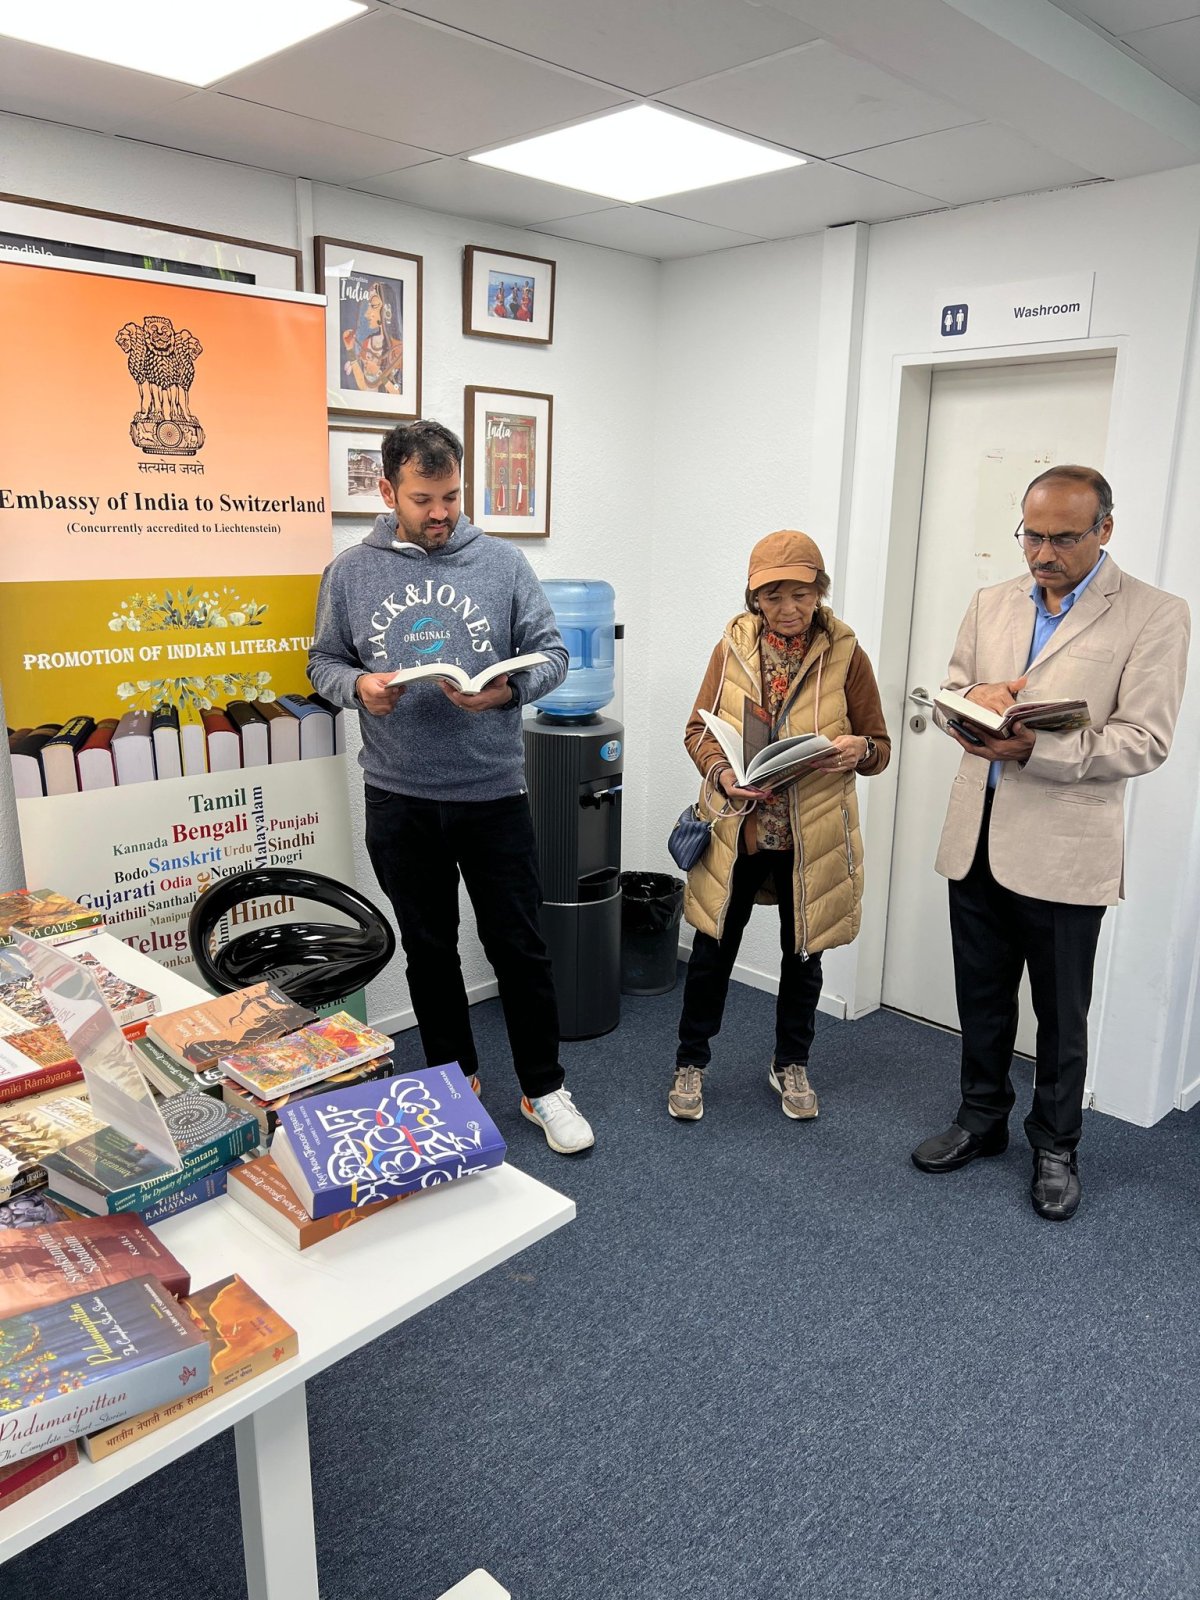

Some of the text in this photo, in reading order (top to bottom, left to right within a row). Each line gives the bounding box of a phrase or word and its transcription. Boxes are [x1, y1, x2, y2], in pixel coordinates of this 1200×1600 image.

[340, 278, 370, 302] India
[1013, 302, 1080, 319] Washroom
[486, 420, 512, 440] India
[138, 460, 205, 475] सत्यमेव जयते
[0, 489, 325, 515] Embassy of India to Switzerland
[66, 522, 281, 535] (Concurrently accredited to Liechtenstein)
[403, 630, 451, 643] ORIGINALS
[23, 648, 134, 670] PROMOTION
[139, 645, 163, 661] OF
[167, 642, 226, 660] INDIAN
[188, 788, 247, 814] Tamil
[171, 813, 248, 844] Bengali
[251, 786, 269, 869] Malayalam
[269, 812, 319, 831] Punjabi
[112, 837, 168, 856] Kannada
[224, 843, 253, 857] Urdu
[267, 831, 315, 852] Sindhi
[148, 847, 222, 874] Sanskrit
[210, 860, 253, 879] Nepali
[270, 850, 303, 867] Dogri
[114, 868, 149, 884] Bodo
[160, 876, 192, 892] Odia
[76, 881, 156, 911] Gujarati
[148, 891, 197, 912] Santhali
[230, 895, 295, 926] Hindi
[43, 921, 78, 936] CAVES
[184, 1146, 219, 1169] Santana
[141, 1193, 152, 1203] The
[152, 1181, 176, 1199] Dynasty
[145, 1193, 198, 1220] RAMAYANA
[69, 1303, 122, 1366] Pudumaipittan
[0, 1392, 127, 1441] Pudumaipittan
[106, 1427, 133, 1447] भारतीय
[137, 1412, 160, 1431] नेपाली
[163, 1401, 184, 1417] नाटक
[0, 1410, 127, 1461] The Complete Short Stories
